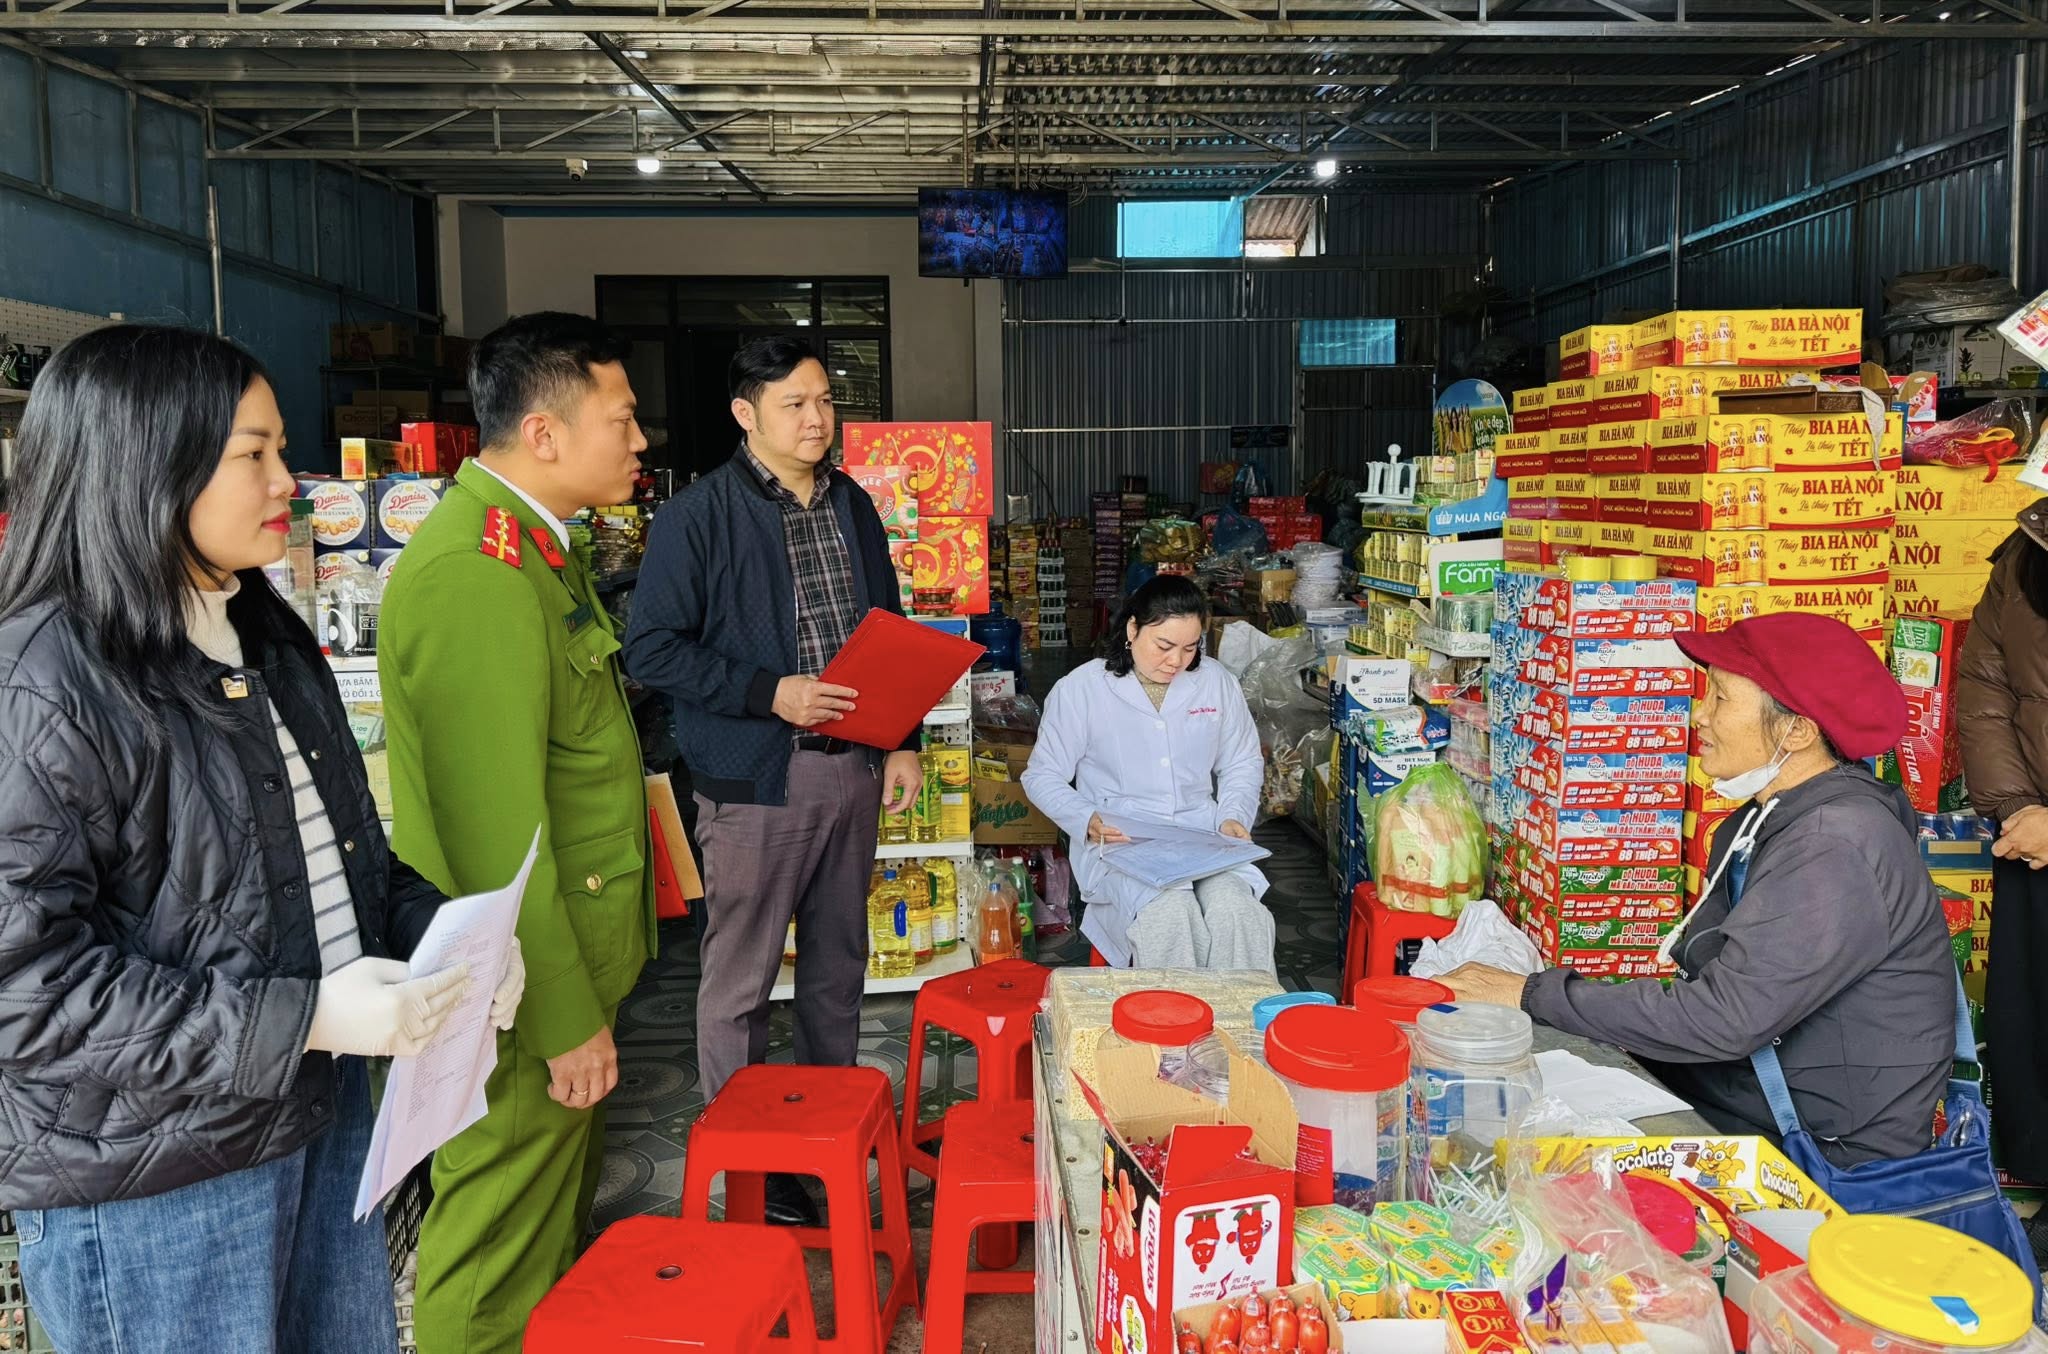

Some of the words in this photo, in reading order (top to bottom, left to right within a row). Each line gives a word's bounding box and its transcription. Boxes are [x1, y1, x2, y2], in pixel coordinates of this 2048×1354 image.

[1771, 318, 1796, 331] BIA
[1798, 314, 1821, 330] HÀ
[1822, 313, 1850, 334] NỘI
[1800, 334, 1830, 351] TẾT
[1604, 380, 1614, 393] BIA
[1615, 376, 1625, 392] HÀ
[1626, 375, 1640, 393] NỘI
[1739, 374, 1760, 387] BIA
[1764, 370, 1782, 387] HÀ
[1557, 388, 1566, 400] BIA
[1567, 384, 1575, 398] HÀ
[1576, 383, 1585, 400] NỘI
[1492, 415, 1504, 433] đẹp
[1662, 426, 1673, 439] BIA
[1674, 421, 1684, 438] HÀ
[1685, 420, 1697, 440] NỘI
[1809, 420, 1834, 434] BIA
[1837, 416, 1859, 434] HÀ
[1862, 420, 1890, 434] NI
[1560, 434, 1569, 445] BIA
[1600, 430, 1610, 441] BIA
[1611, 425, 1621, 440] HÀ
[1622, 424, 1635, 442] NỘI
[1506, 440, 1516, 450] BIA
[1517, 436, 1527, 449] HÀ
[1527, 435, 1540, 450] NỘI
[1839, 438, 1869, 456] TẾT
[857, 477, 882, 488] WEE
[1556, 480, 1565, 491] BIA
[1609, 479, 1619, 491] BIA
[1620, 475, 1629, 491] HÀ
[1630, 475, 1641, 494] NỘI
[1802, 480, 1828, 495] BIA
[1830, 475, 1854, 494] HÀ
[1856, 473, 1884, 498] NỘI
[1896, 470, 1920, 484] BIA
[1656, 482, 1668, 495] BIA
[1668, 478, 1678, 495] HÀ
[1679, 479, 1691, 498] NỘI
[314, 492, 350, 510] Danisa
[388, 491, 427, 510] Danisa
[1833, 497, 1863, 516] TẾT
[1904, 487, 1944, 516] NỘI
[1455, 512, 1480, 524] MUA
[1484, 511, 1507, 522] NGA
[1601, 528, 1611, 541] BIA
[1612, 527, 1621, 542] HÀ
[1622, 528, 1634, 545] NỘI
[1895, 525, 1918, 538] BIA
[1653, 534, 1665, 548] BIA
[1667, 533, 1678, 549] HÀ
[1679, 534, 1693, 552] NỘI
[1801, 536, 1826, 549] BIA
[1828, 530, 1848, 549] HÀ
[1851, 530, 1879, 552] NỘI
[1830, 552, 1858, 571] TẾT
[1889, 541, 1900, 564] À
[1904, 541, 1941, 569] NỘI
[1648, 583, 1672, 595] HUDA
[1895, 579, 1917, 592] BIA
[1794, 592, 1819, 606] BIA
[1821, 588, 1844, 606] HÀ
[1845, 587, 1873, 609] NỘI
[1634, 621, 1648, 634] 88
[1382, 668, 1398, 676] you!
[1634, 680, 1648, 692] 88
[1641, 700, 1665, 712] HUDA
[1626, 737, 1641, 749] 88
[1637, 757, 1662, 768] HUDA
[1623, 793, 1638, 806] 88
[1631, 812, 1657, 823] HUDA
[1618, 849, 1633, 862] 88
[1634, 869, 1658, 880] HUDA
[1620, 906, 1634, 919] 88
[1634, 924, 1658, 935] HUDA
[1618, 962, 1632, 974] 88
[1616, 1146, 1674, 1173] ocolate
[1760, 1161, 1803, 1208] Chocolate
[1148, 1208, 1157, 1231] LC
[1147, 1232, 1157, 1294] FOODS
